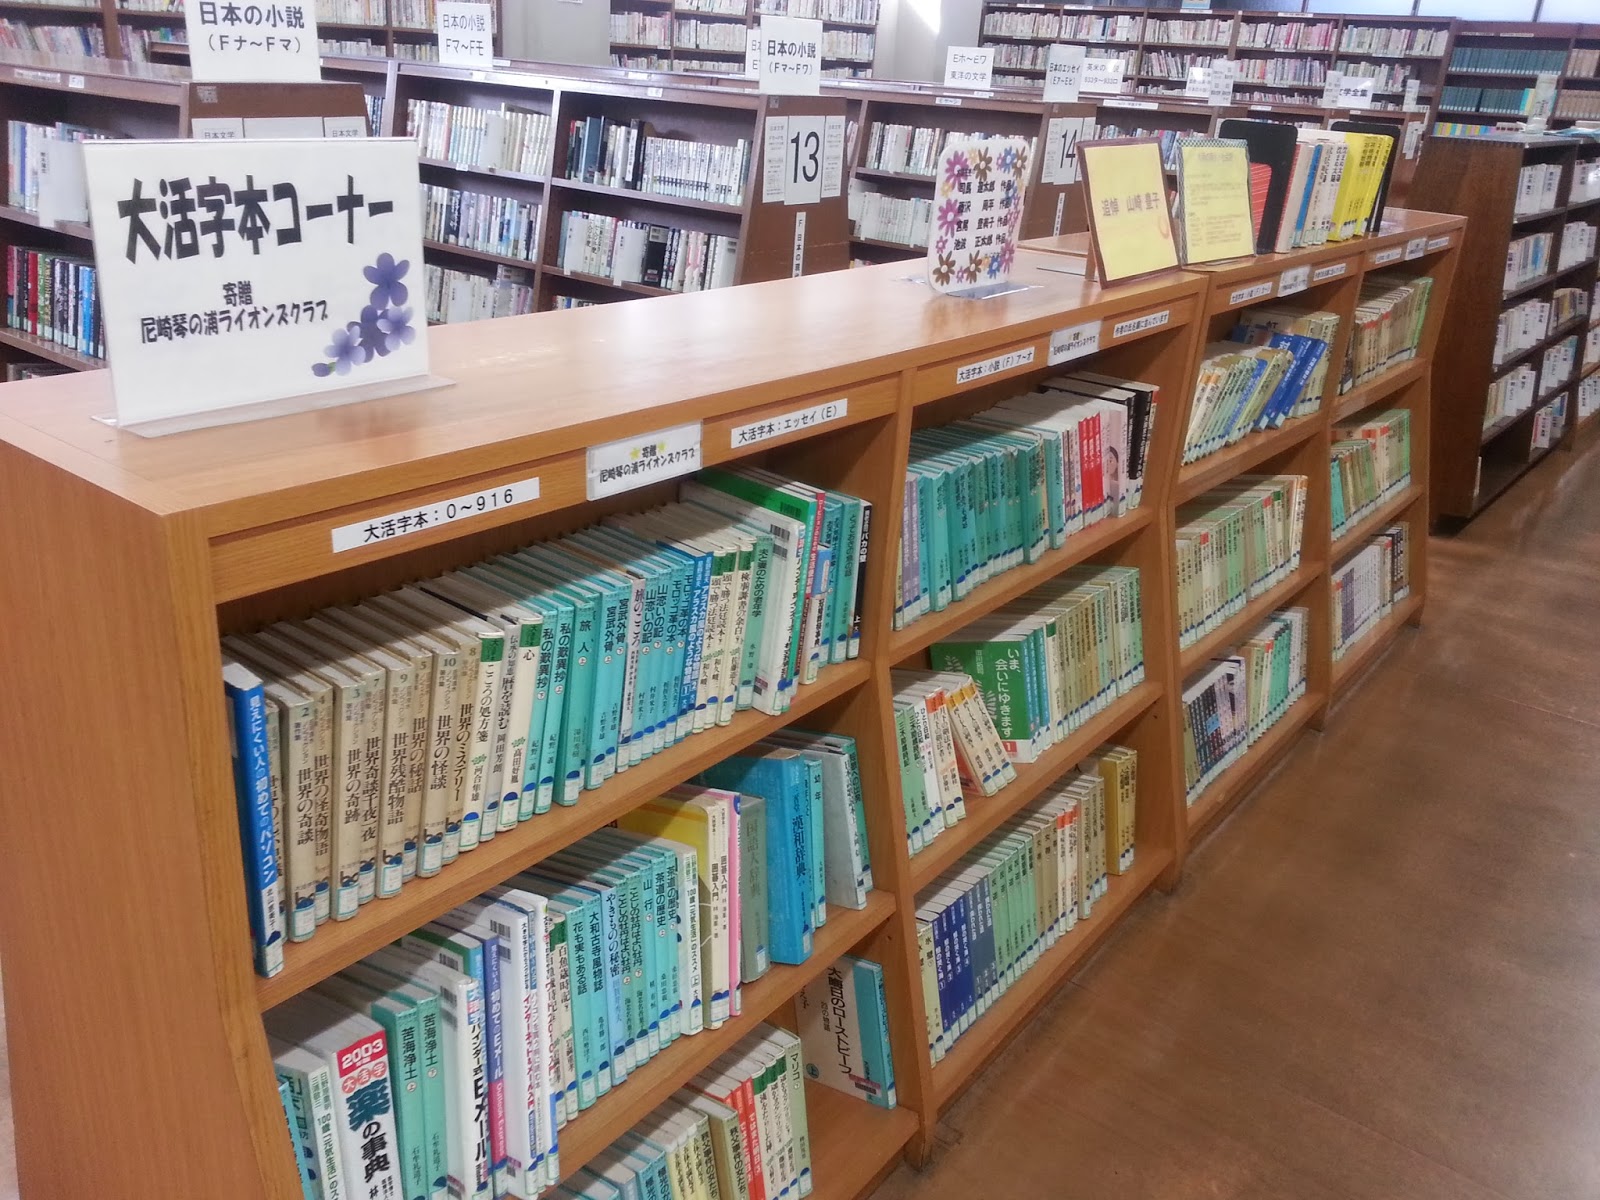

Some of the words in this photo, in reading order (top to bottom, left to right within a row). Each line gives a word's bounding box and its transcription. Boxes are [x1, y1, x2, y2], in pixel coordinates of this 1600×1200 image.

[200, 1, 305, 29] 日本の小説
[443, 13, 485, 31] 日本の小説
[446, 38, 484, 56] Fマ～Fモ
[767, 40, 817, 59] 日本の小説
[1049, 62, 1081, 73] 日本のエッセイ
[1086, 63, 1120, 73] 英米の説
[950, 70, 987, 81] 東洋の文学
[204, 131, 235, 139] 日本文学
[332, 130, 358, 138] 日本文学
[790, 131, 821, 184] 13
[1060, 129, 1078, 169] 14
[959, 181, 972, 194] 司馬
[1000, 179, 1012, 192] 作品
[117, 174, 394, 265] 大活字本コーナー
[974, 234, 993, 248] 正太郎
[995, 232, 1007, 246] 作品
[997, 215, 1009, 228] 作品
[222, 281, 254, 305] 寄贈
[140, 300, 328, 344] 尼崎琴の浦ライオンズクラブ
[599, 447, 696, 484] 尼崎琴の浦ライオンズクラブ
[641, 444, 658, 458] 寄贈
[363, 488, 514, 543] 大活字本：0～916
[858, 532, 869, 563] バカの壁
[677, 574, 694, 638] モロッコ革の本
[734, 572, 750, 635] 検事調書の余白
[751, 548, 769, 618] 夫と妻のための老年学
[603, 605, 617, 653] 宮武外骨
[615, 598, 630, 644] 宮武外骨
[631, 588, 645, 650] 旅のこころ
[642, 588, 657, 645] 山恋いの記
[652, 583, 669, 639] 山恋いの記
[665, 579, 682, 644] モロッコ革の本
[853, 614, 862, 625] 上
[468, 647, 476, 656] 8
[522, 649, 535, 661] 心
[536, 628, 554, 689] 私の歎異抄
[554, 622, 572, 683] 私の歎異抄
[577, 619, 592, 654] 旅人
[373, 678, 380, 687] 7
[400, 673, 408, 684] 9
[420, 661, 427, 670] 5
[443, 657, 457, 667] 10
[578, 657, 587, 666] 上
[1007, 648, 1022, 673] いま、
[301, 708, 310, 717] 2
[353, 688, 361, 698] 3
[475, 664, 495, 743] こころの処方箋
[498, 676, 515, 730] 暦を読む
[554, 685, 564, 694] 上
[994, 658, 1013, 738] 会いにゆきます
[408, 716, 427, 794] 世界の秘話
[430, 714, 452, 791] 世界の怪談
[455, 703, 474, 802] 世界のミステリー
[249, 694, 276, 884] 見えにくい人の初めてのパソコン
[344, 748, 362, 825] 世界の奇跡
[362, 736, 381, 842] 世界奇談千夜一夜
[387, 732, 408, 826] 世界残酷物語
[470, 765, 484, 802] 河合隼雄
[813, 773, 822, 802] 幼年
[297, 769, 314, 846] 世界の奇談
[313, 755, 330, 856] 世界の怪奇物語
[791, 814, 806, 880] 漢和辞典
[665, 866, 678, 920] 茶道の歴史
[711, 862, 719, 901] 囲碁入門
[720, 855, 728, 893] 囲碁入門
[654, 872, 667, 928] 茶道の歴史
[605, 892, 621, 979] やきものの秘密
[617, 893, 632, 975] ことしの牡丹はよい牡丹
[629, 886, 643, 968] ことしの牡丹はよい牡丹
[573, 921, 588, 996] 花も実もある話
[589, 911, 604, 993] 大和古寺風物誌
[423, 1013, 438, 1067] 苦海浄土
[827, 966, 852, 1074] 大晦日のローストビーフ
[341, 1038, 384, 1070] 2003
[401, 1026, 418, 1082] 苦海浄土
[470, 1023, 483, 1076] ハインター式
[790, 1052, 801, 1082] マリコ
[342, 1060, 387, 1094] 大活字
[406, 1081, 417, 1093] 上
[474, 1077, 487, 1163] Eメール
[700, 1130, 718, 1198] 秩父事件の女たち
[729, 1125, 747, 1198] 秩父事件の女たち
